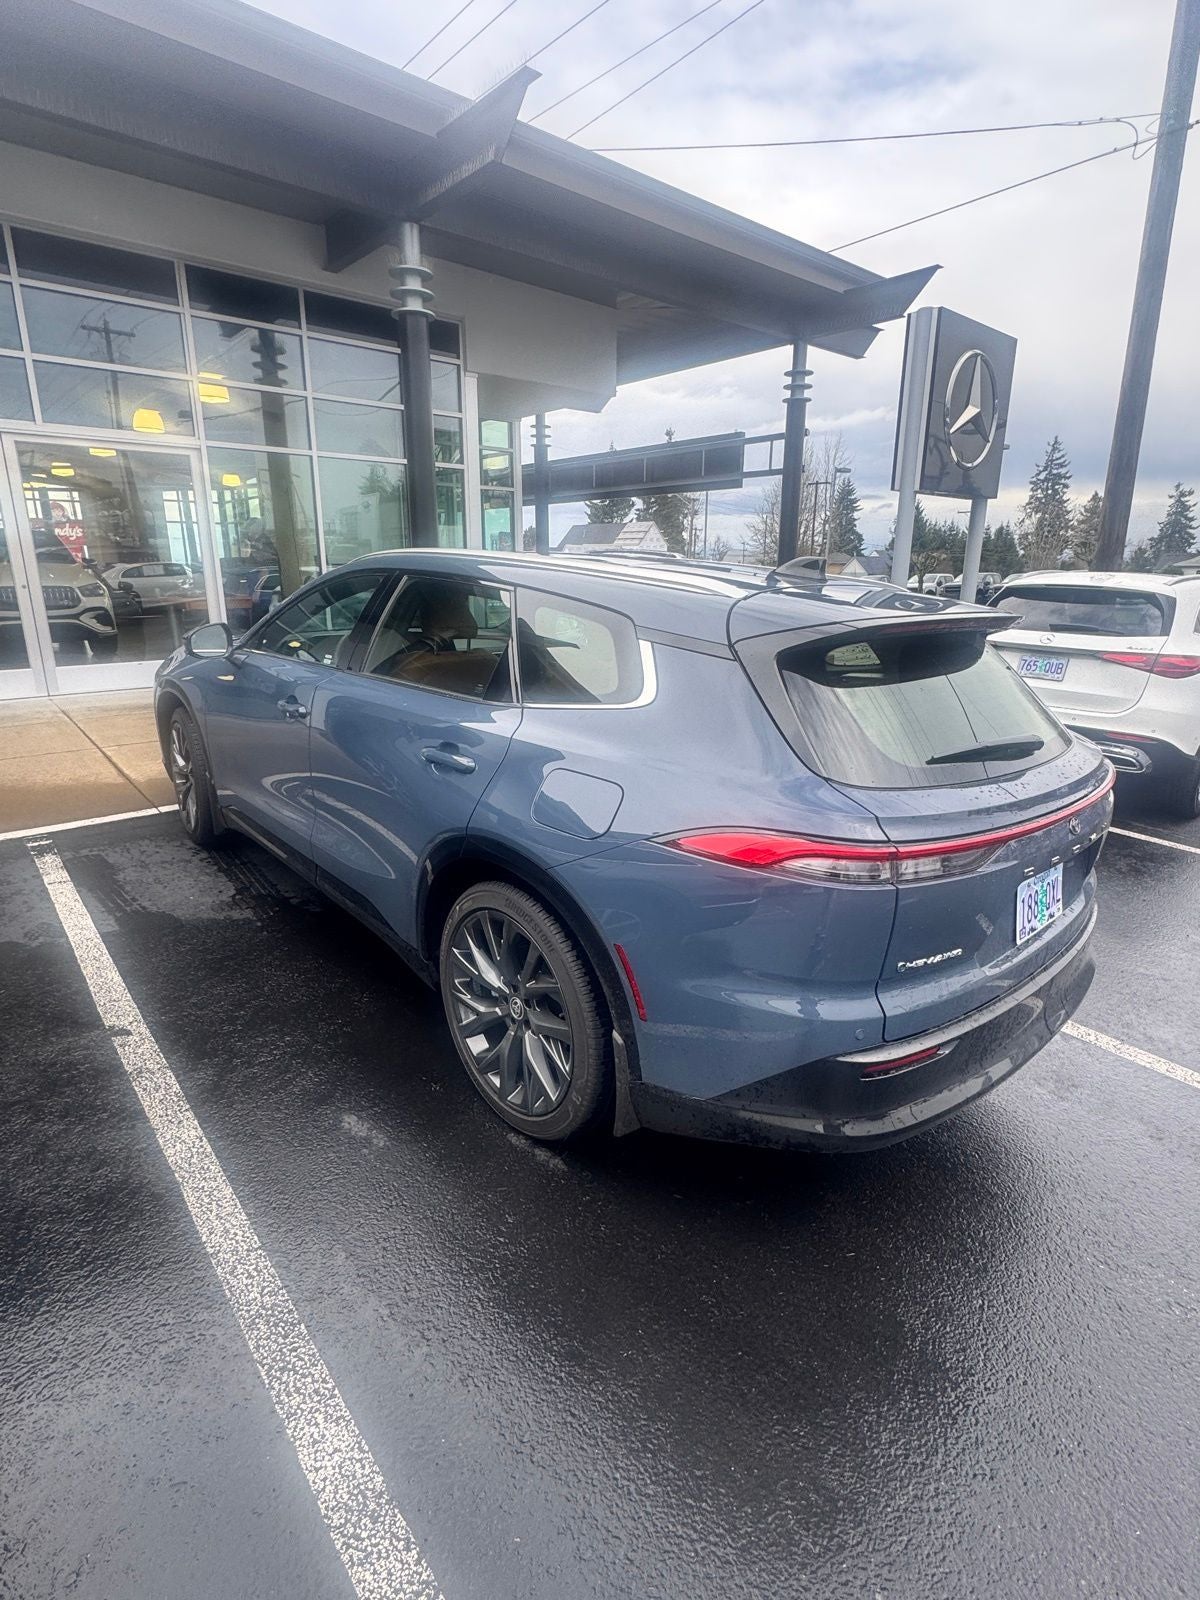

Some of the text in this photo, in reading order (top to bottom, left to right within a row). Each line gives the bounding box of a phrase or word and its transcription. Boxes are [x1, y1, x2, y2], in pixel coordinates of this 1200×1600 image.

[54, 523, 83, 540] ndy's
[1021, 659, 1039, 671] 765
[1022, 889, 1039, 929] 188
